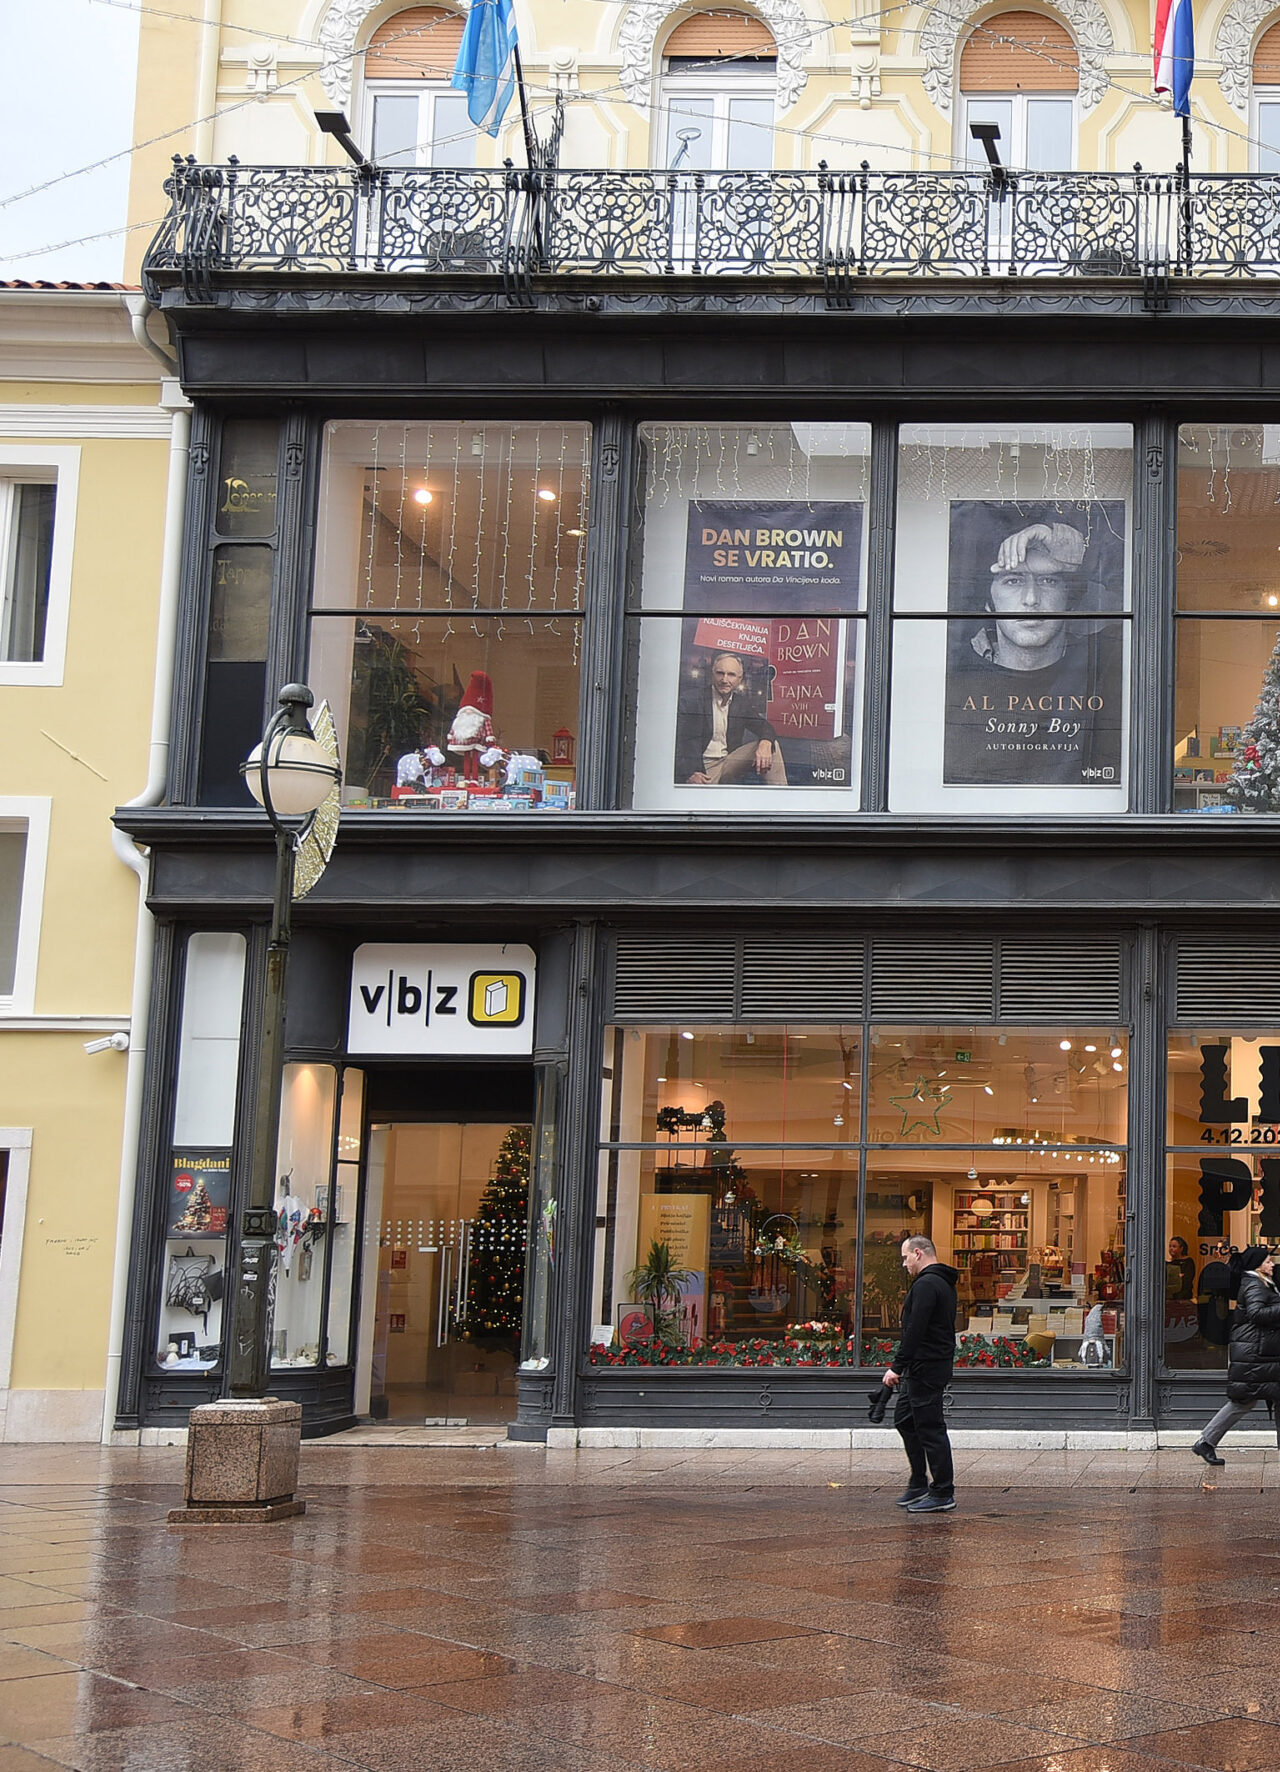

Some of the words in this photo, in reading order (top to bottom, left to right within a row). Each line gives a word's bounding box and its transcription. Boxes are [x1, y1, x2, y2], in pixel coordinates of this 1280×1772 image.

[702, 528, 750, 546] DAN
[756, 530, 843, 548] BROWN
[713, 550, 739, 567] SE
[745, 551, 834, 569] VRATIO.
[700, 575, 717, 583] Novi
[785, 576, 819, 586] Vincijeva
[778, 619, 831, 642] DAN
[738, 633, 767, 645] KNJIGA
[778, 642, 830, 662] BROWN
[780, 685, 823, 701] TAJNA
[962, 696, 996, 711] AL
[1008, 695, 1104, 711] PACINO
[781, 712, 818, 728] TAJNI
[986, 718, 1040, 738] Sonny
[1048, 718, 1081, 738] Boy
[986, 743, 1080, 752] AUTOBIOGRAFIJA
[174, 1158, 230, 1170] Blagdani
